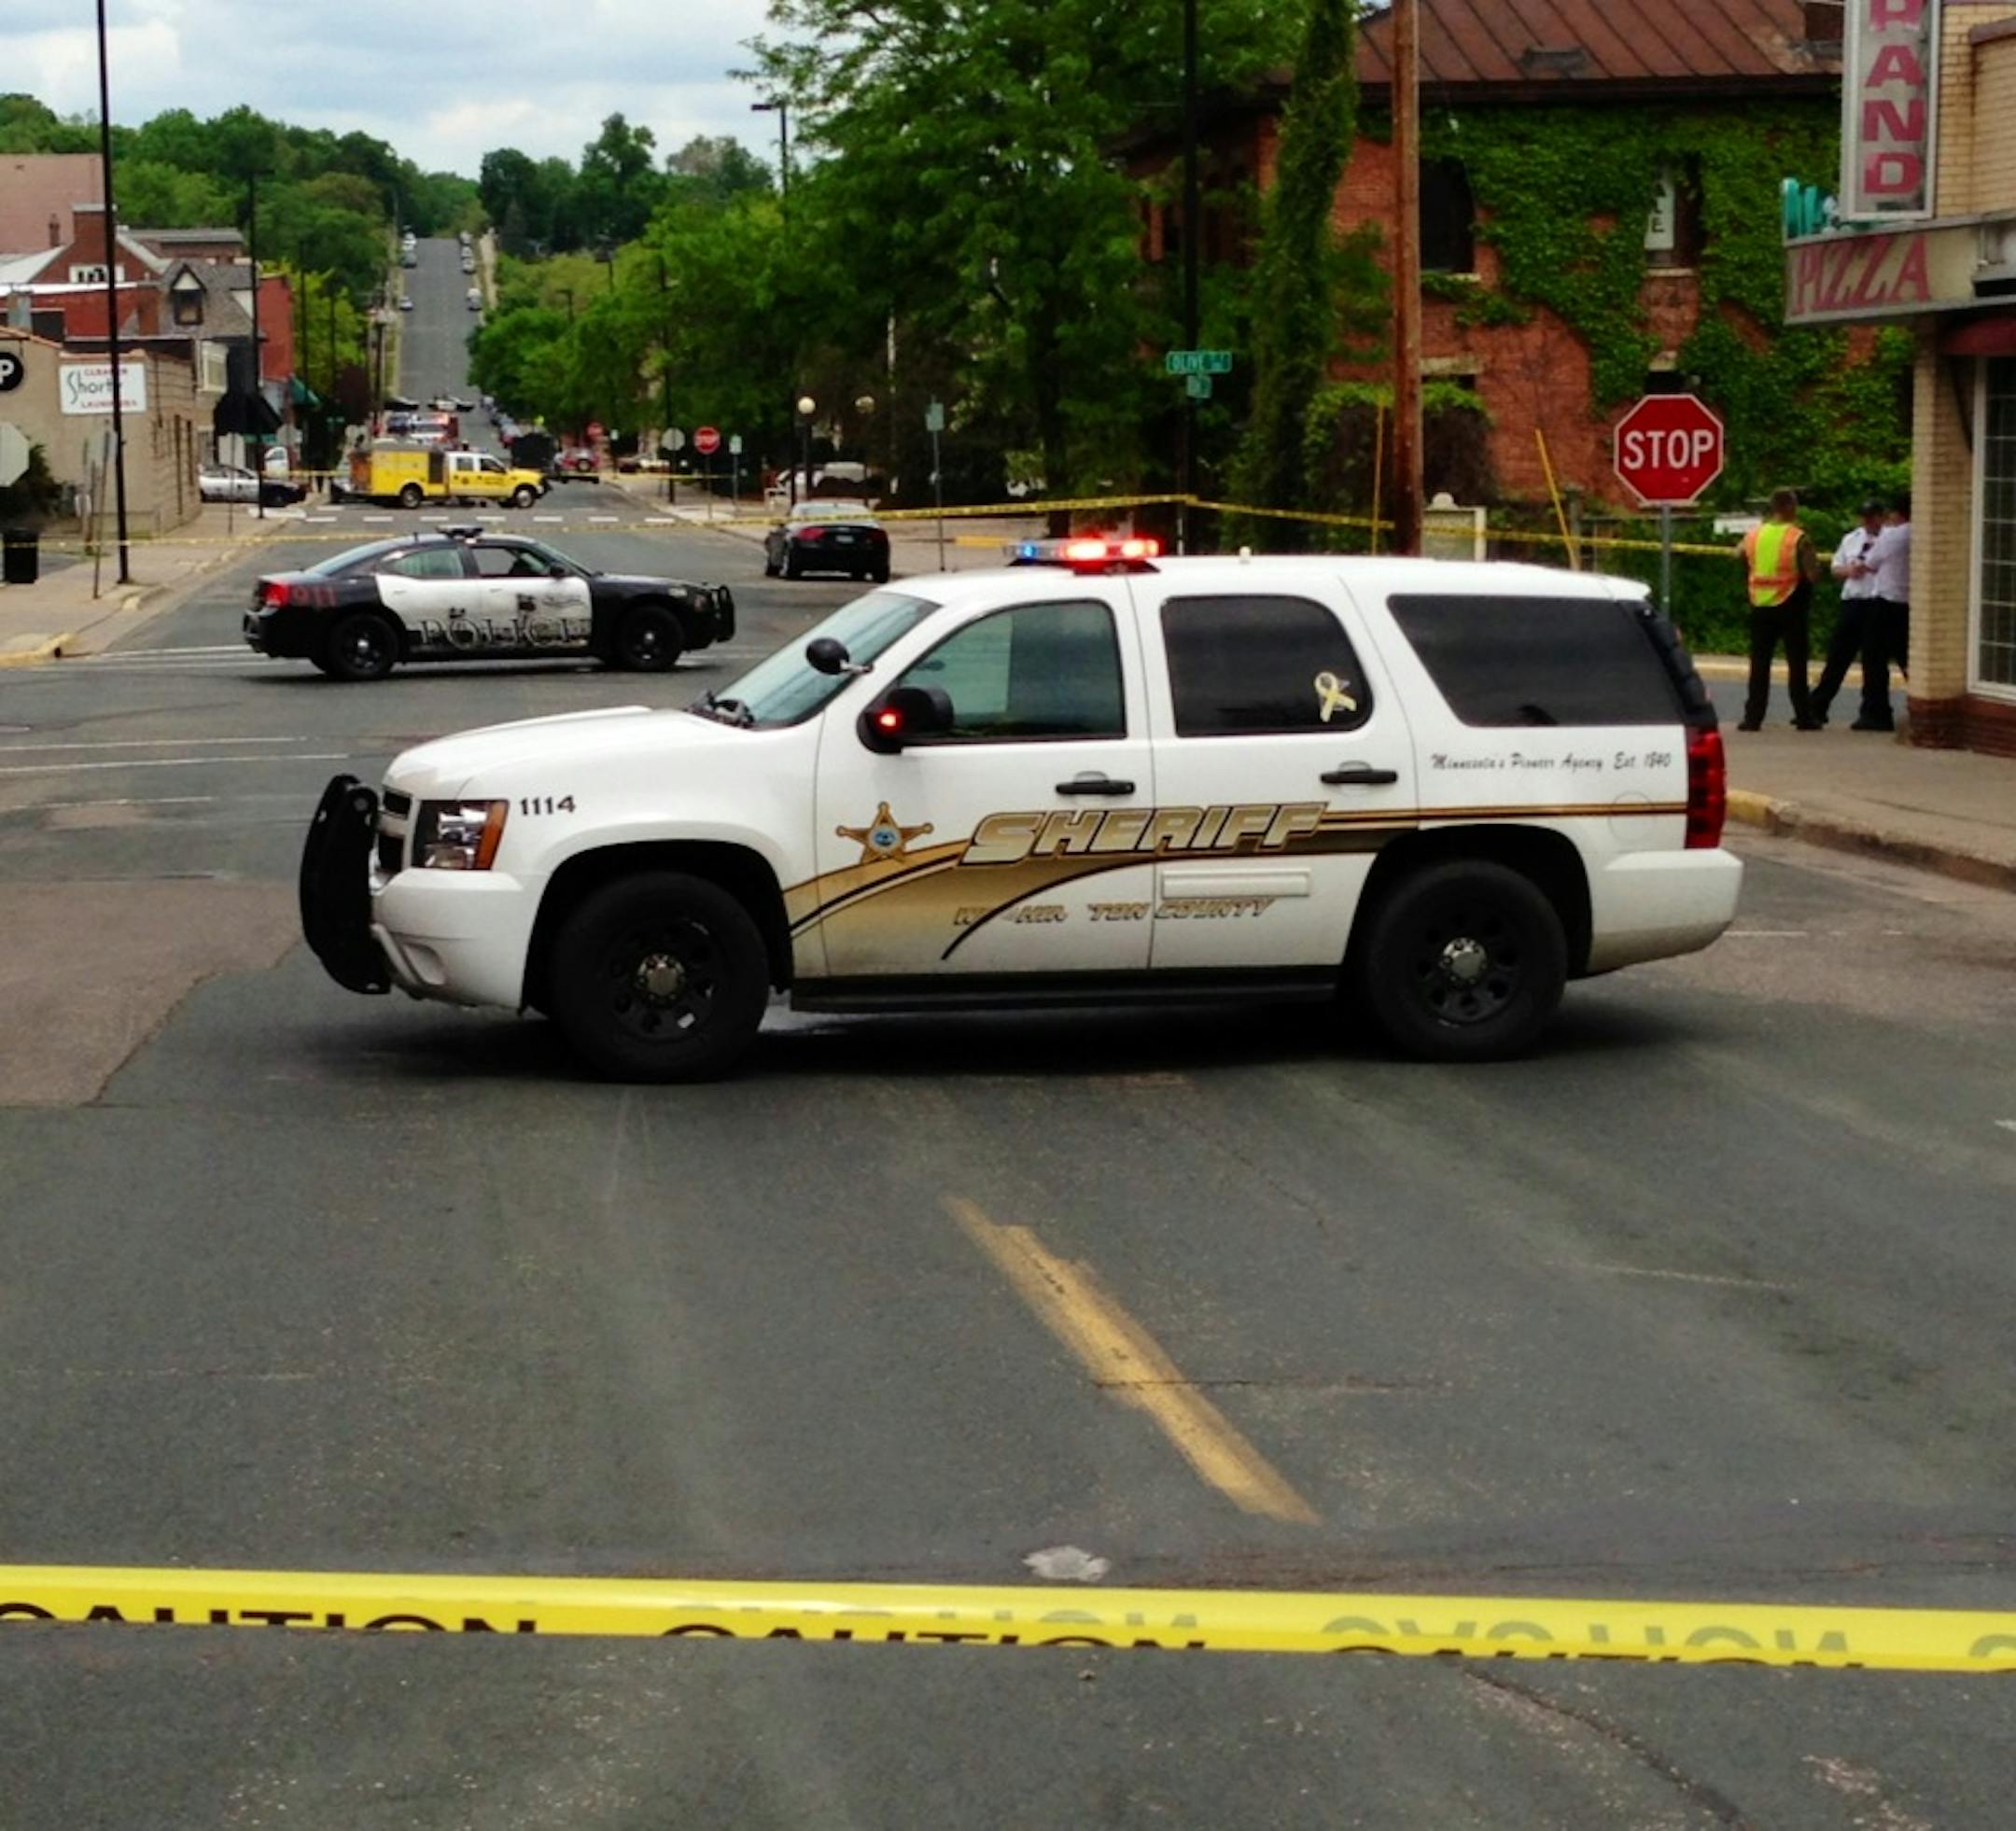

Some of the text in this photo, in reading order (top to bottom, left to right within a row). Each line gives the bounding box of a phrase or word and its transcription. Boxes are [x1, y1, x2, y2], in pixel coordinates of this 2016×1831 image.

[1790, 233, 1932, 316] PIZZA
[1623, 429, 1715, 469] STOP
[1561, 752, 1603, 773] Agency
[520, 794, 576, 816] 1114
[959, 802, 1330, 867] SHERIFF
[1154, 899, 1276, 920] COUNTY
